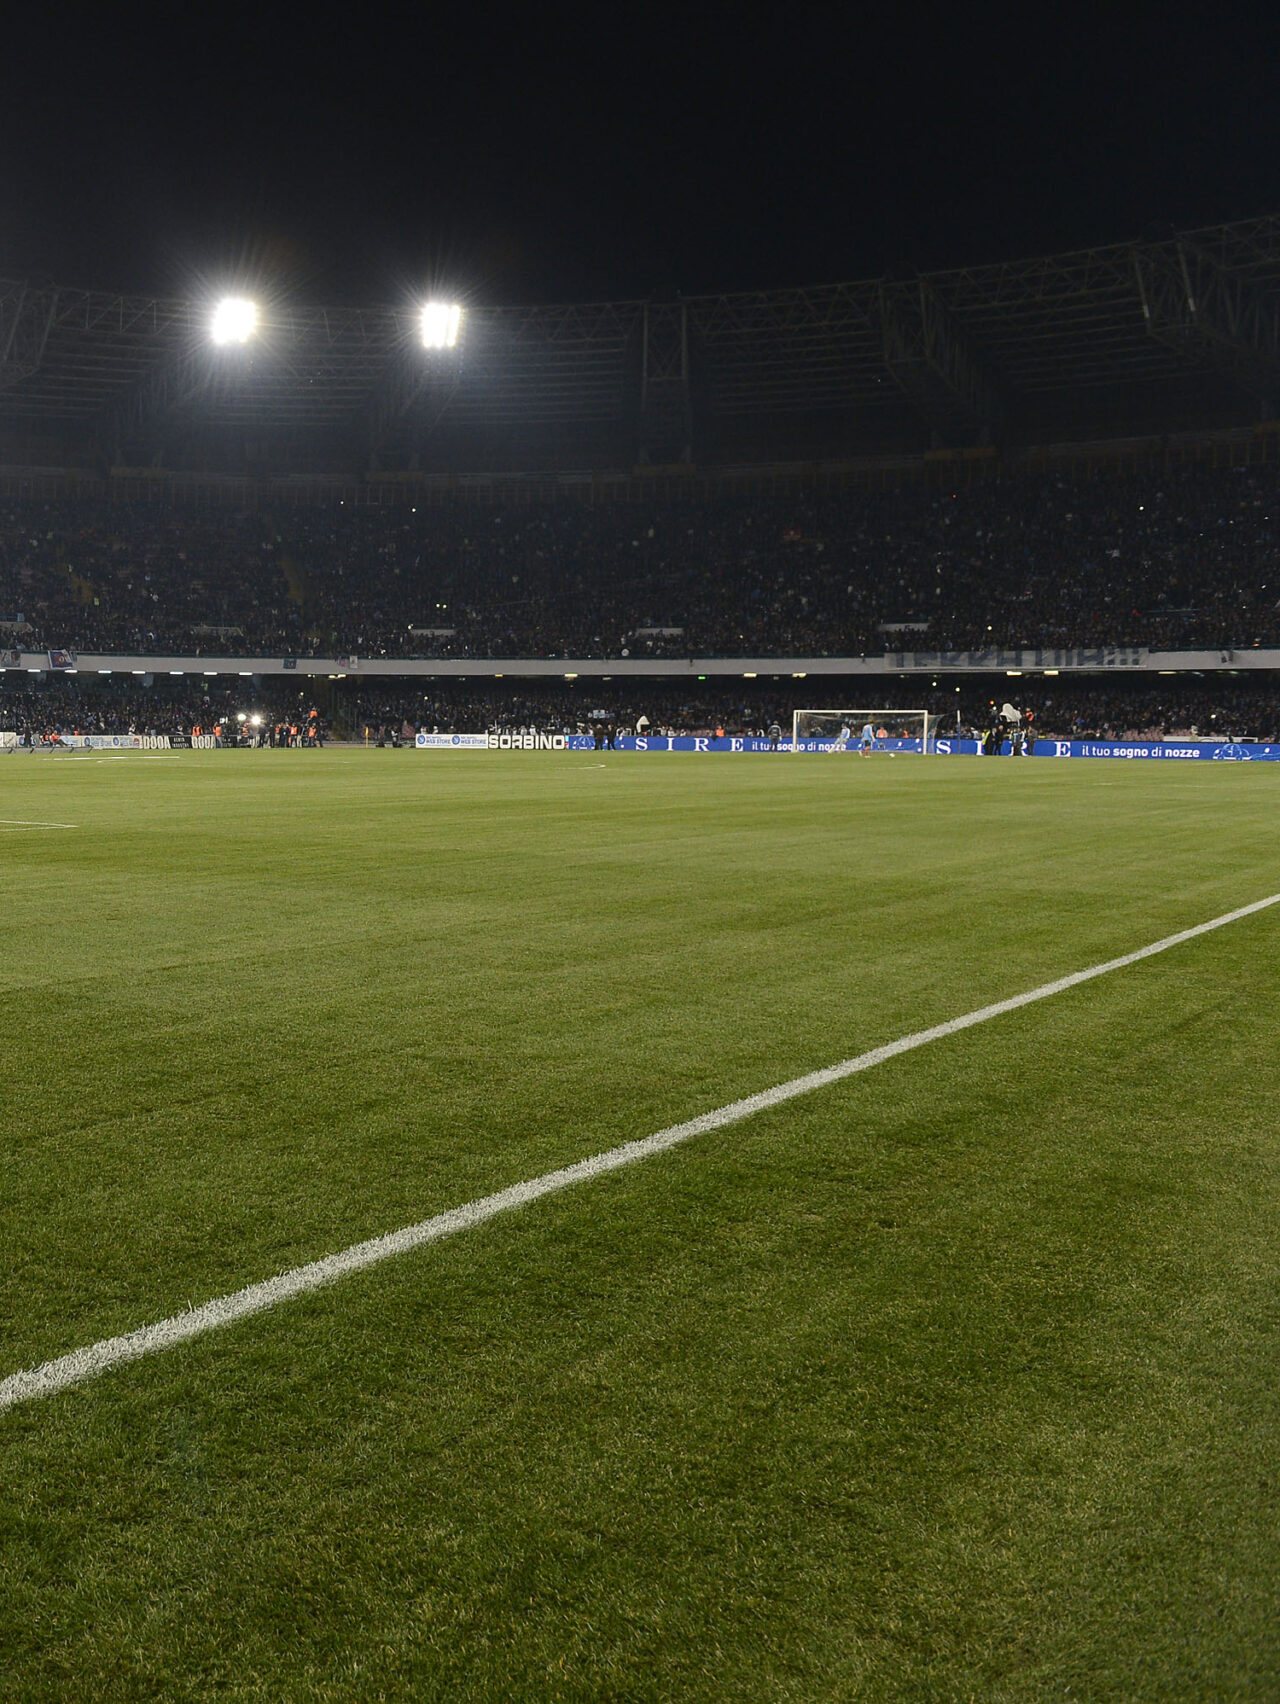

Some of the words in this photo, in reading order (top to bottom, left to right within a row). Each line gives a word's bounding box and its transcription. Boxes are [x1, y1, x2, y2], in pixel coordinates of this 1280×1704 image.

[488, 734, 566, 750] SORBINO
[807, 742, 817, 750] di
[1082, 745, 1089, 756] il
[1092, 746, 1110, 757] tuo
[1113, 747, 1149, 759] sogno
[1151, 746, 1162, 757] di
[1164, 748, 1201, 758] nozze
